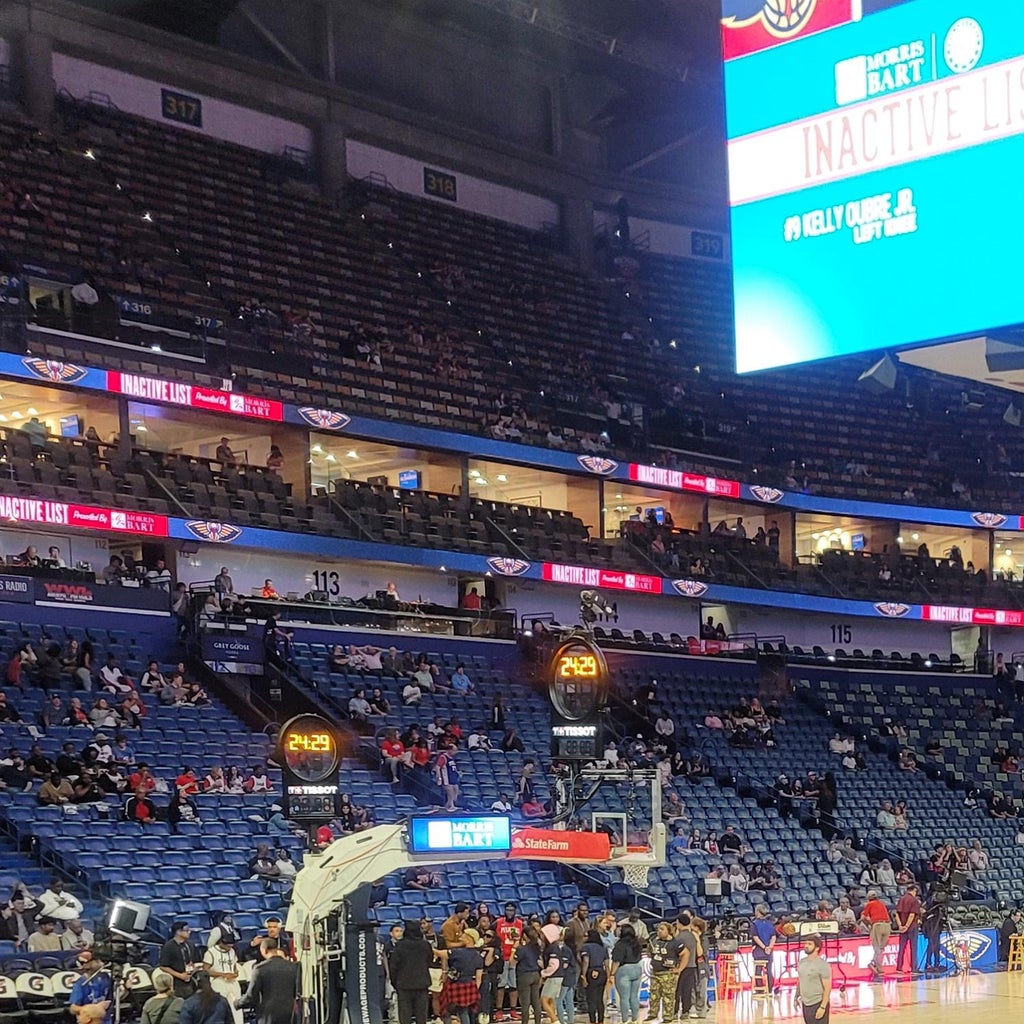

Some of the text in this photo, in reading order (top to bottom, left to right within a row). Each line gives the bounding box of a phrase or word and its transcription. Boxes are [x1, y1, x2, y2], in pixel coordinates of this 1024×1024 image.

[866, 40, 925, 71] MORRIS
[867, 58, 925, 95] BART
[165, 95, 198, 120] 317
[803, 85, 962, 178] INACTIVE
[427, 171, 454, 195] 318
[802, 204, 844, 237] KELLY
[853, 221, 884, 244] LEFT
[131, 302, 151, 315] 316
[195, 315, 212, 328] 317
[120, 373, 168, 401] INACTIVE
[170, 384, 192, 406] LIST
[245, 405, 270, 417] BART
[638, 464, 668, 484] INACTIVE
[668, 470, 683, 489] LIST
[0, 495, 43, 521] NACTIVE
[44, 501, 69, 524] LIST
[127, 522, 154, 532] BART
[313, 570, 340, 596] 113
[551, 564, 584, 584] INACTIVE
[584, 568, 600, 586] LIST
[5, 581, 27, 592] RADIO
[929, 606, 959, 622] INACTIVE
[959, 607, 973, 622] LIST
[830, 624, 852, 644] 115
[230, 643, 250, 651] GOOSE
[560, 656, 597, 676] 24:29
[566, 726, 597, 736] TISSOT
[289, 734, 330, 751] 24:29
[303, 785, 338, 794] TISSOT
[452, 832, 494, 847] BART
[28, 976, 44, 991] G
